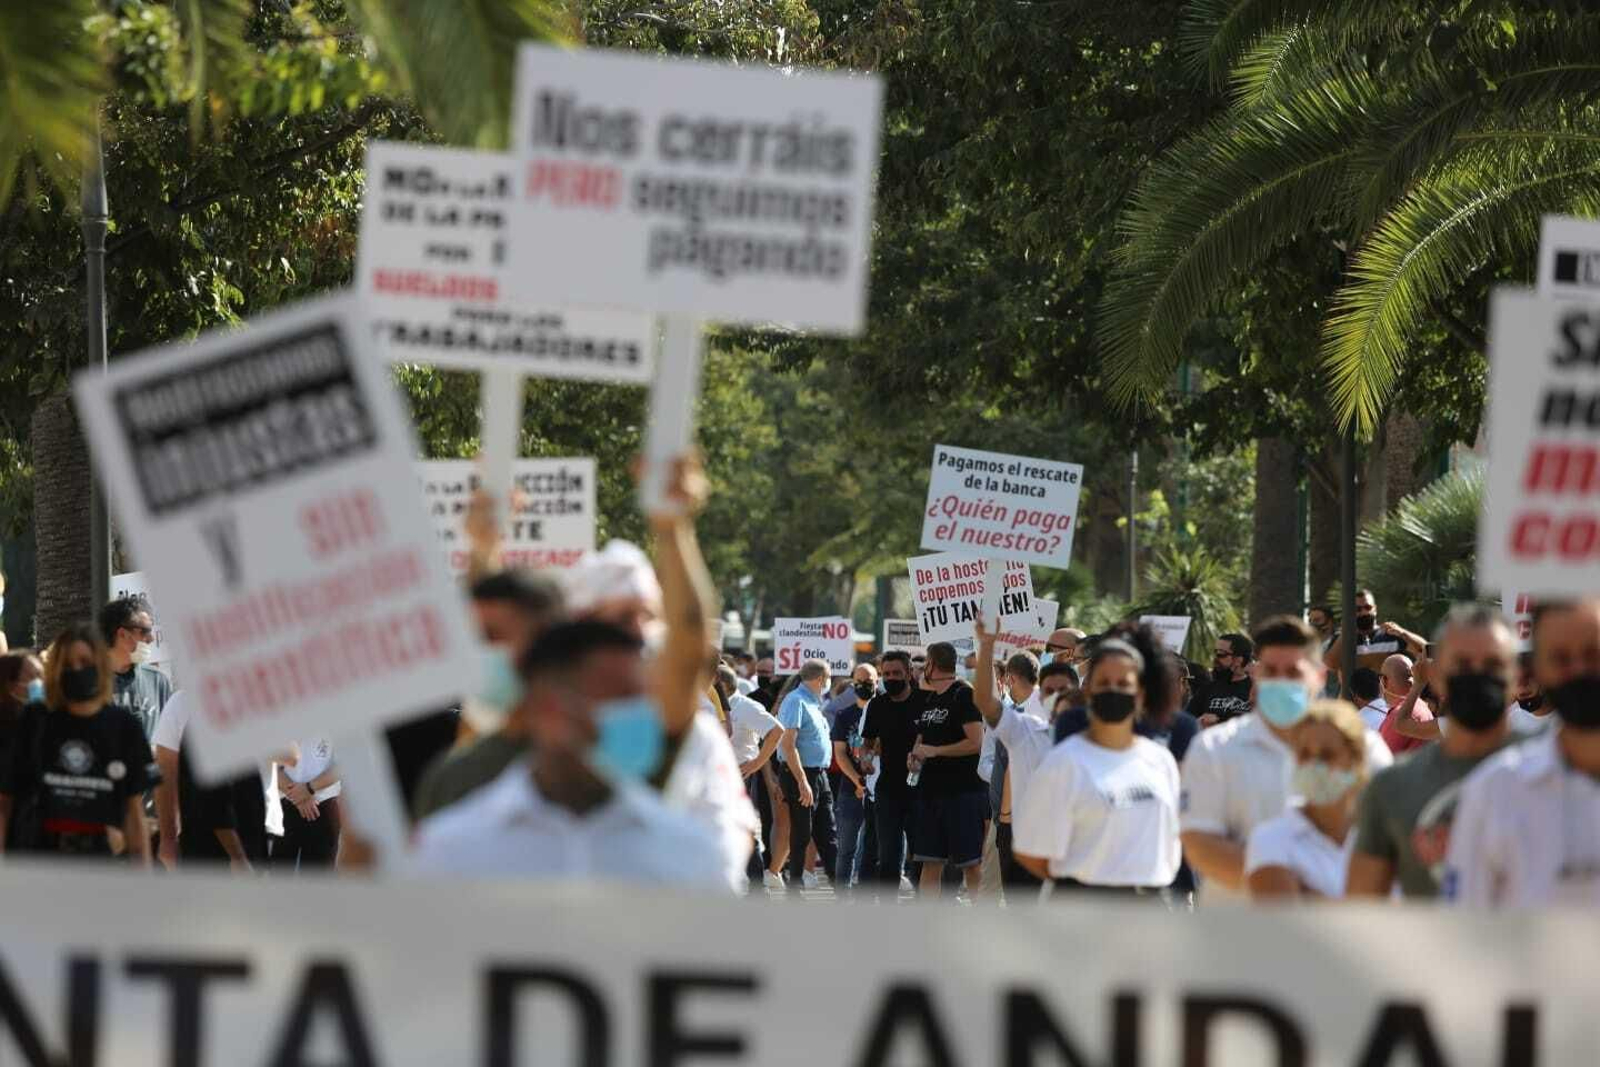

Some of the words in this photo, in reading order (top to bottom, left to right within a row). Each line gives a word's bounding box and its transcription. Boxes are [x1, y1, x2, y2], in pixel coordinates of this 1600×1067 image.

[533, 88, 638, 155] Nos
[528, 160, 622, 210] PERO
[634, 174, 849, 222] seguimos
[938, 451, 1004, 473] Pagamos
[1008, 462, 1021, 476] el
[1024, 465, 1078, 484] rescate
[964, 474, 982, 490] de
[985, 477, 998, 492] la
[1002, 479, 1046, 498] banca
[928, 495, 1007, 521] ¿Quién
[1011, 508, 1071, 534] paga
[935, 520, 957, 541] el
[961, 526, 1061, 555] nuestro?
[916, 568, 933, 586] De
[937, 566, 950, 582] la
[919, 579, 985, 603] comemos
[922, 597, 949, 633] ¡TÚ
[950, 586, 1030, 623] TAMIÉN!
[822, 622, 848, 640] NO
[779, 641, 801, 670] SÍ
[803, 648, 826, 659] Ocio
[484, 962, 759, 1067] DE
